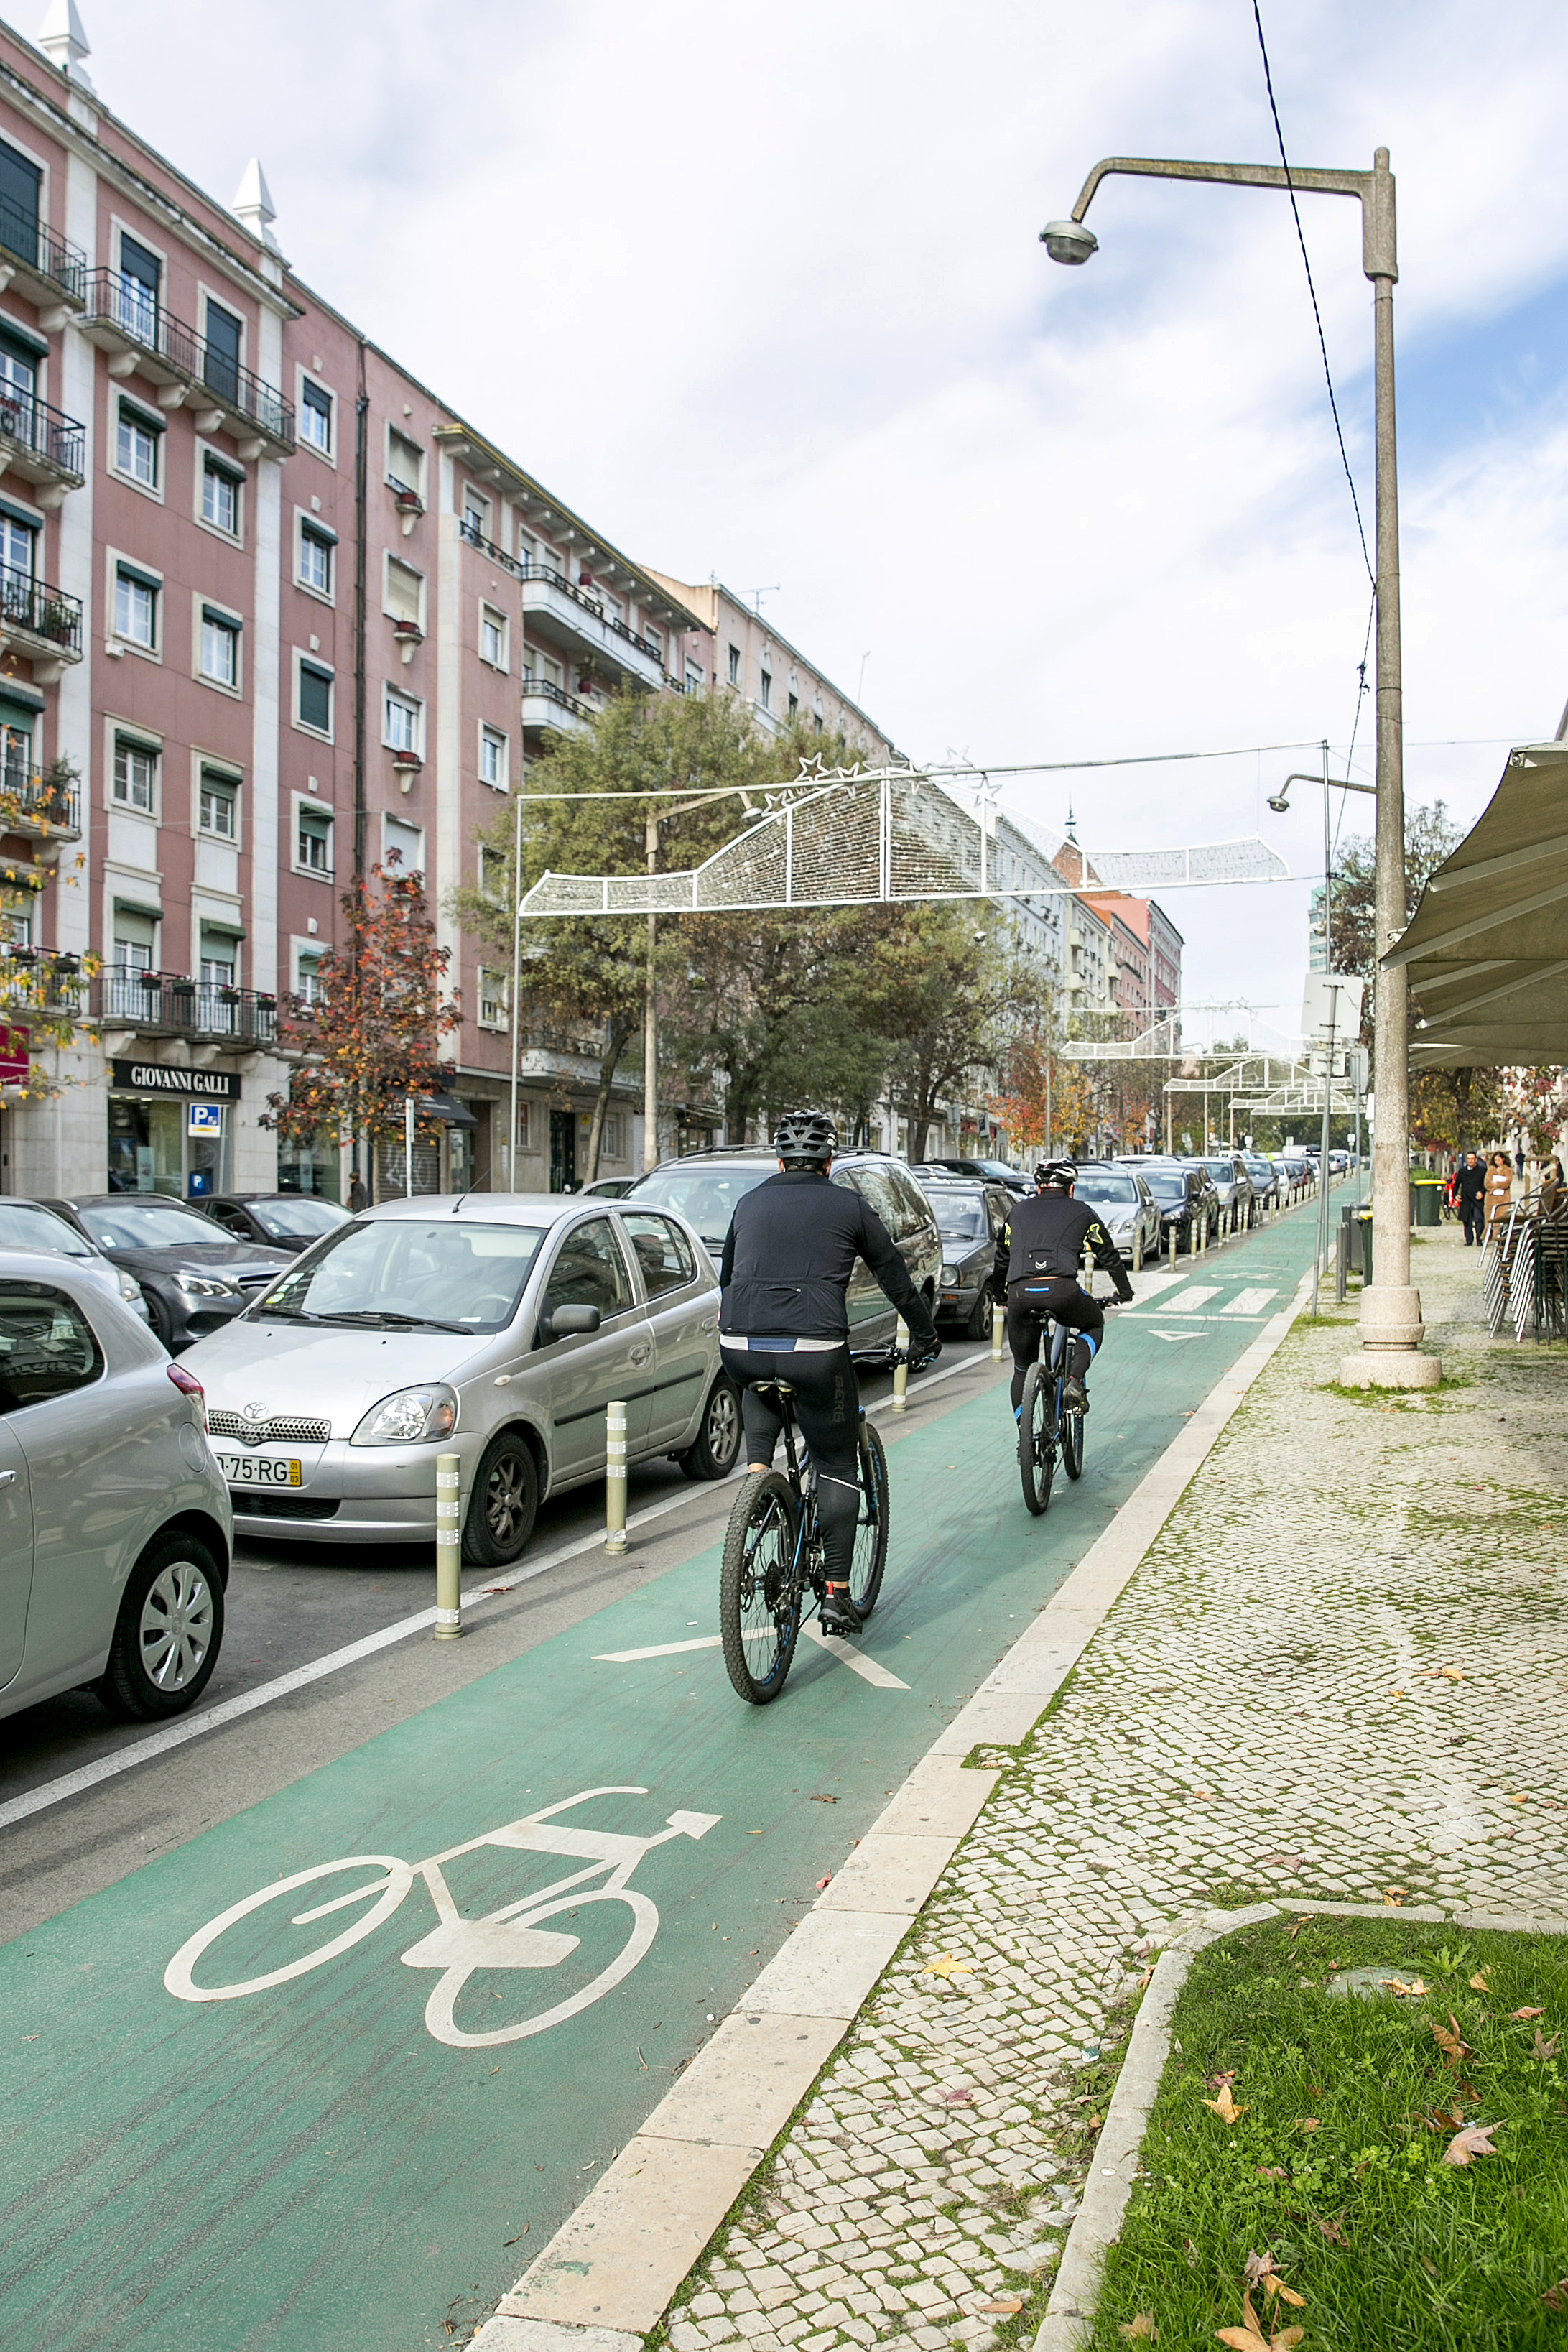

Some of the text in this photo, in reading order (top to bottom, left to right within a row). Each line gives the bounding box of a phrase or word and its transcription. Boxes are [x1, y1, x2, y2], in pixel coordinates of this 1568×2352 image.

[131, 1066, 229, 1094] GIOVANNI GALLI
[195, 1107, 208, 1124] P
[834, 1375, 845, 1422] BERG
